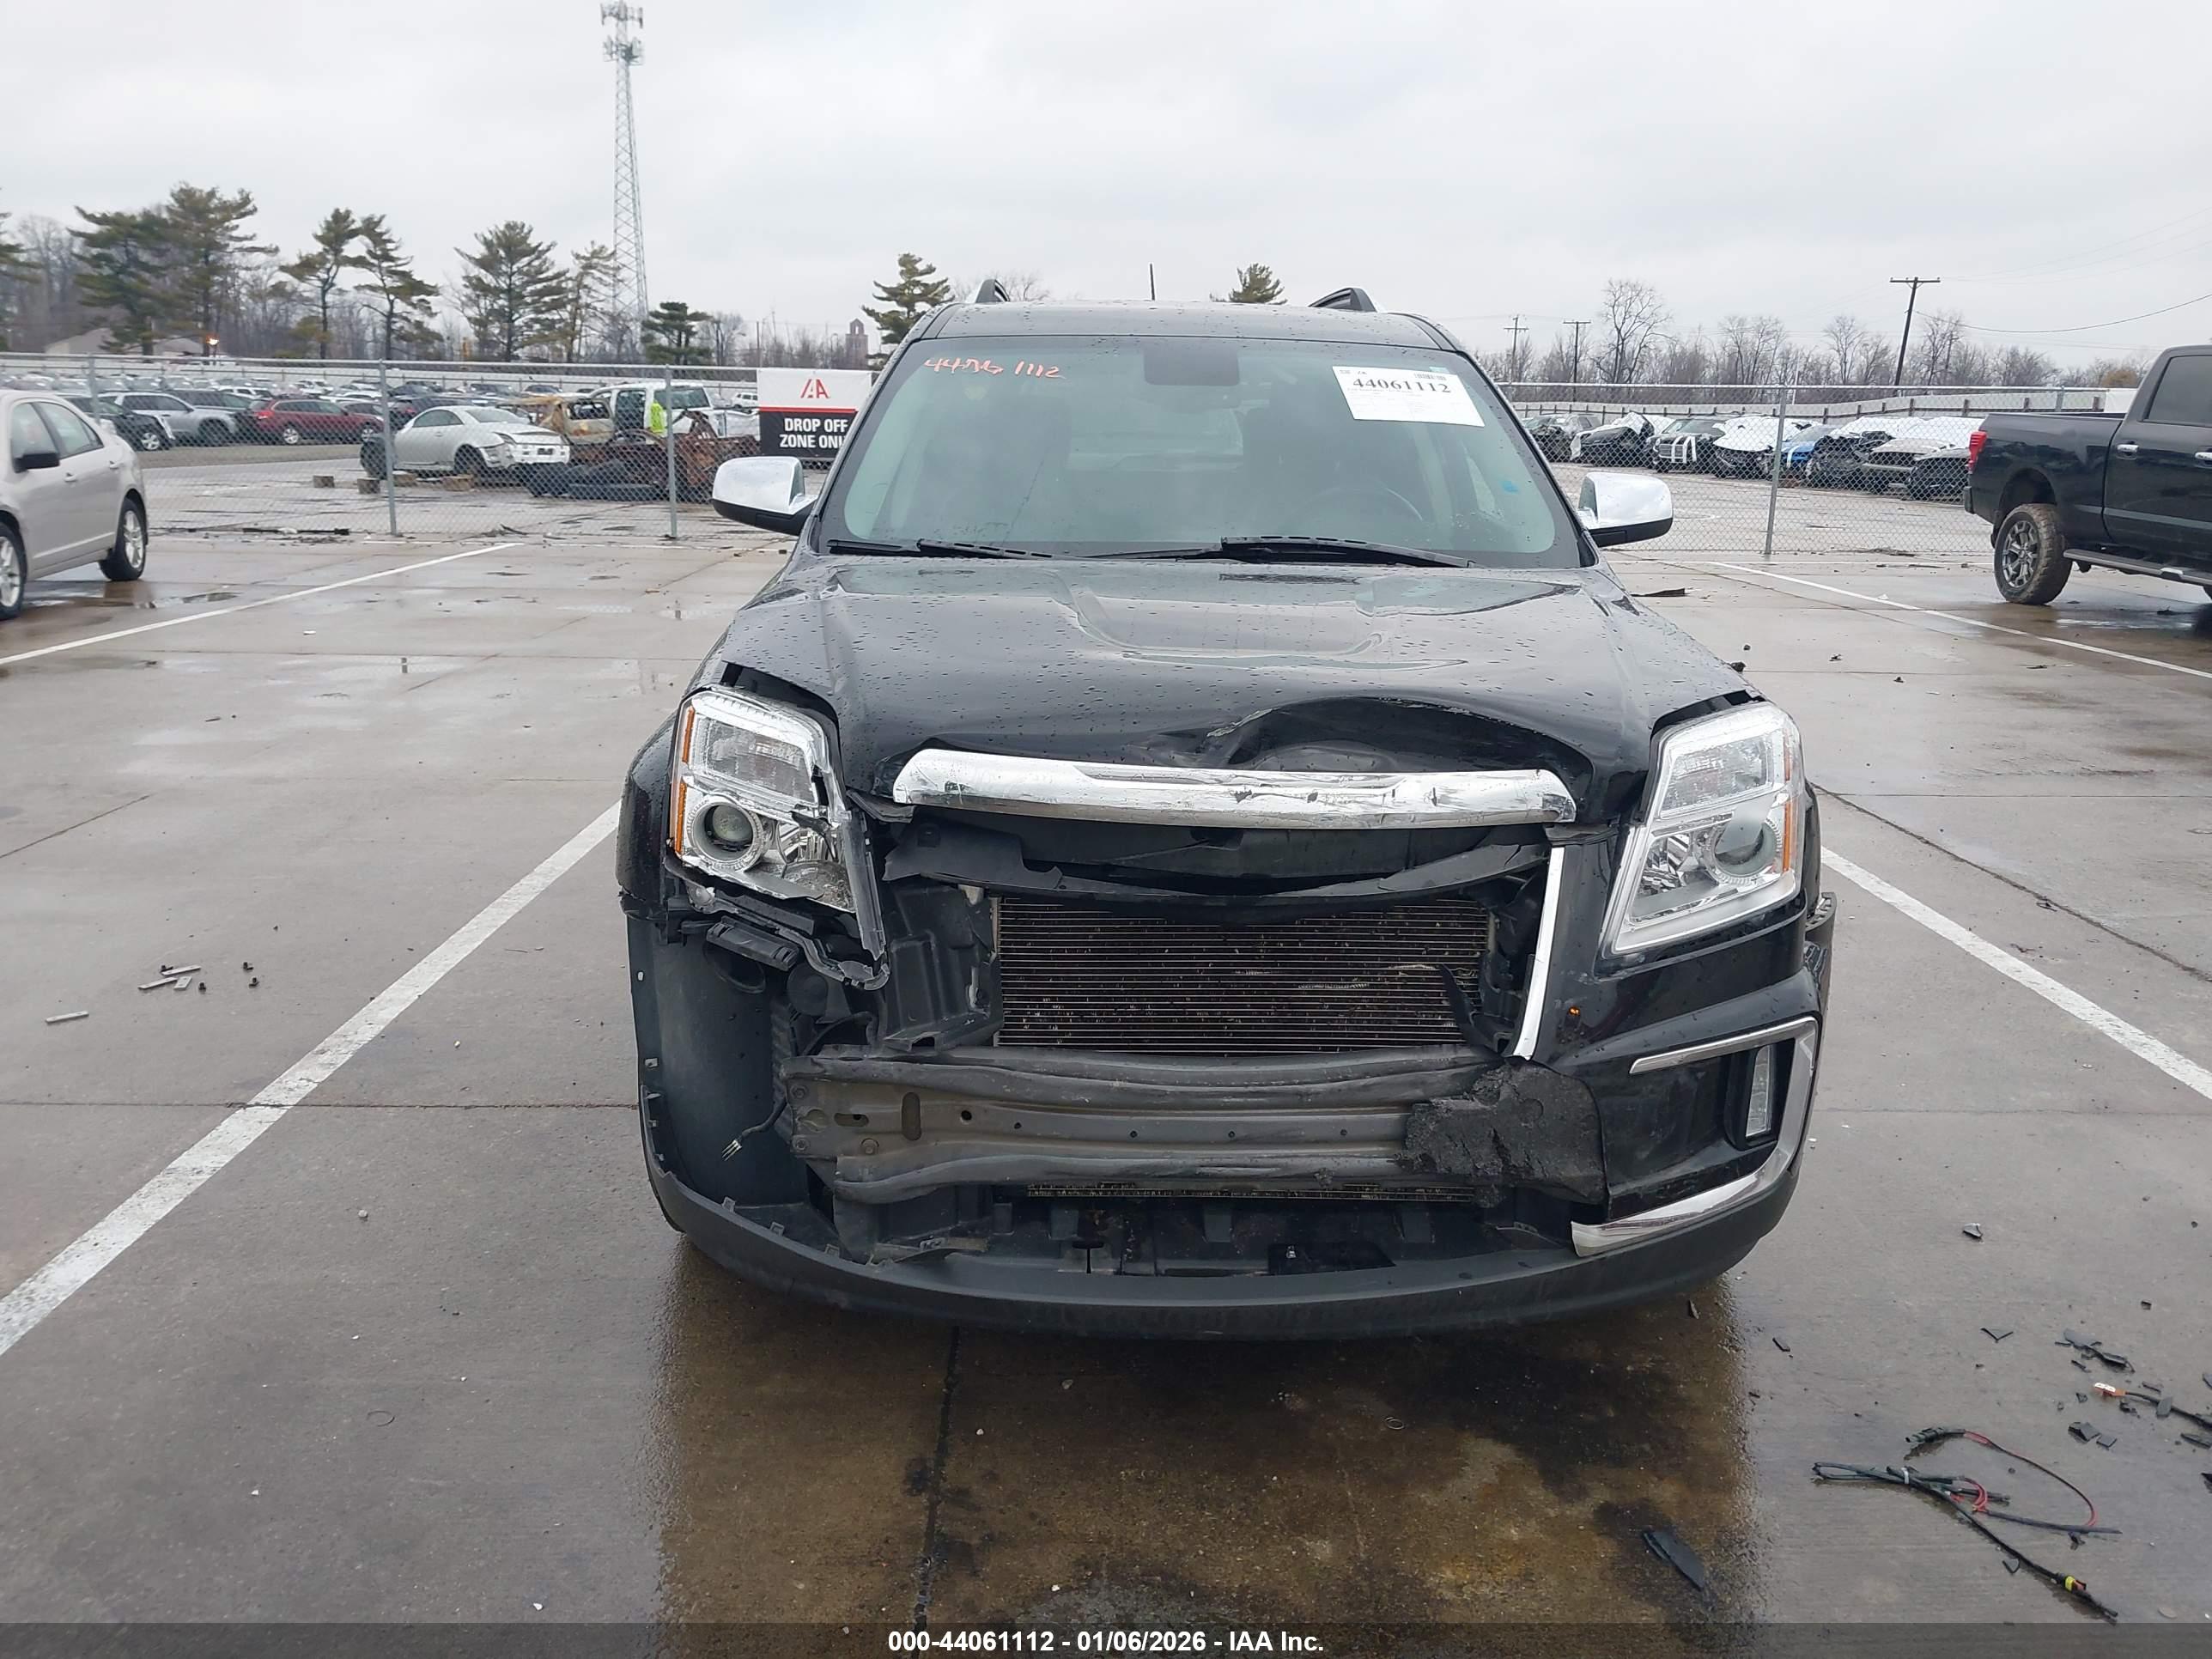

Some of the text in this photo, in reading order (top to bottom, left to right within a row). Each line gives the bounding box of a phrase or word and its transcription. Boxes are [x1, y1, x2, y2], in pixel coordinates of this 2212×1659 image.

[1352, 378, 1452, 393] 44061112
[784, 418, 848, 433] DROP OFF
[779, 434, 816, 448] ZONE
